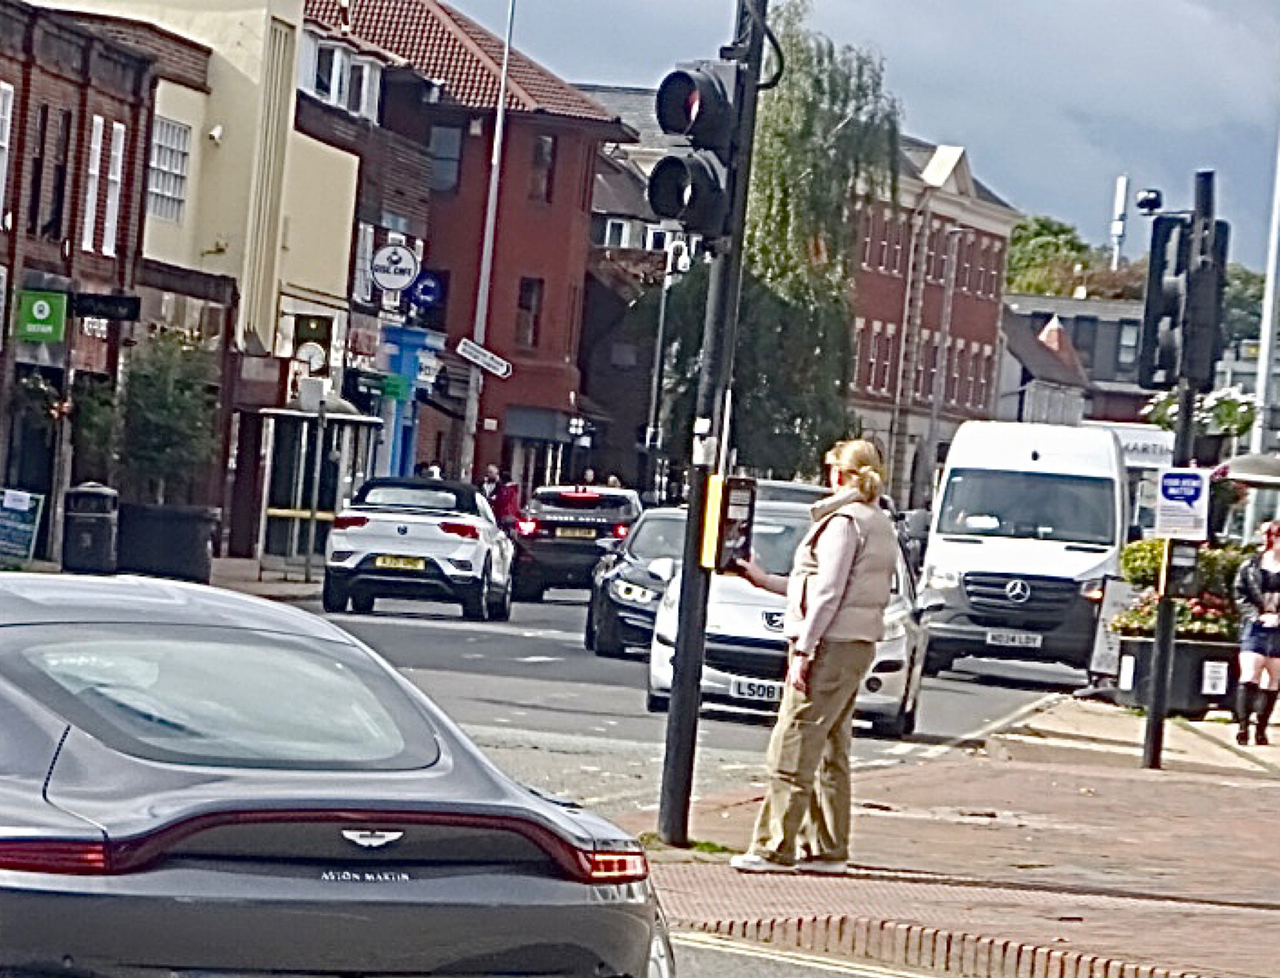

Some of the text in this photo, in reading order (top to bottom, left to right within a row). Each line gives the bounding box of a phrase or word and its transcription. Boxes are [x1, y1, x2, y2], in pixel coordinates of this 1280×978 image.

[737, 681, 775, 698] LS08
[321, 871, 409, 882] ASTON MARTIN
